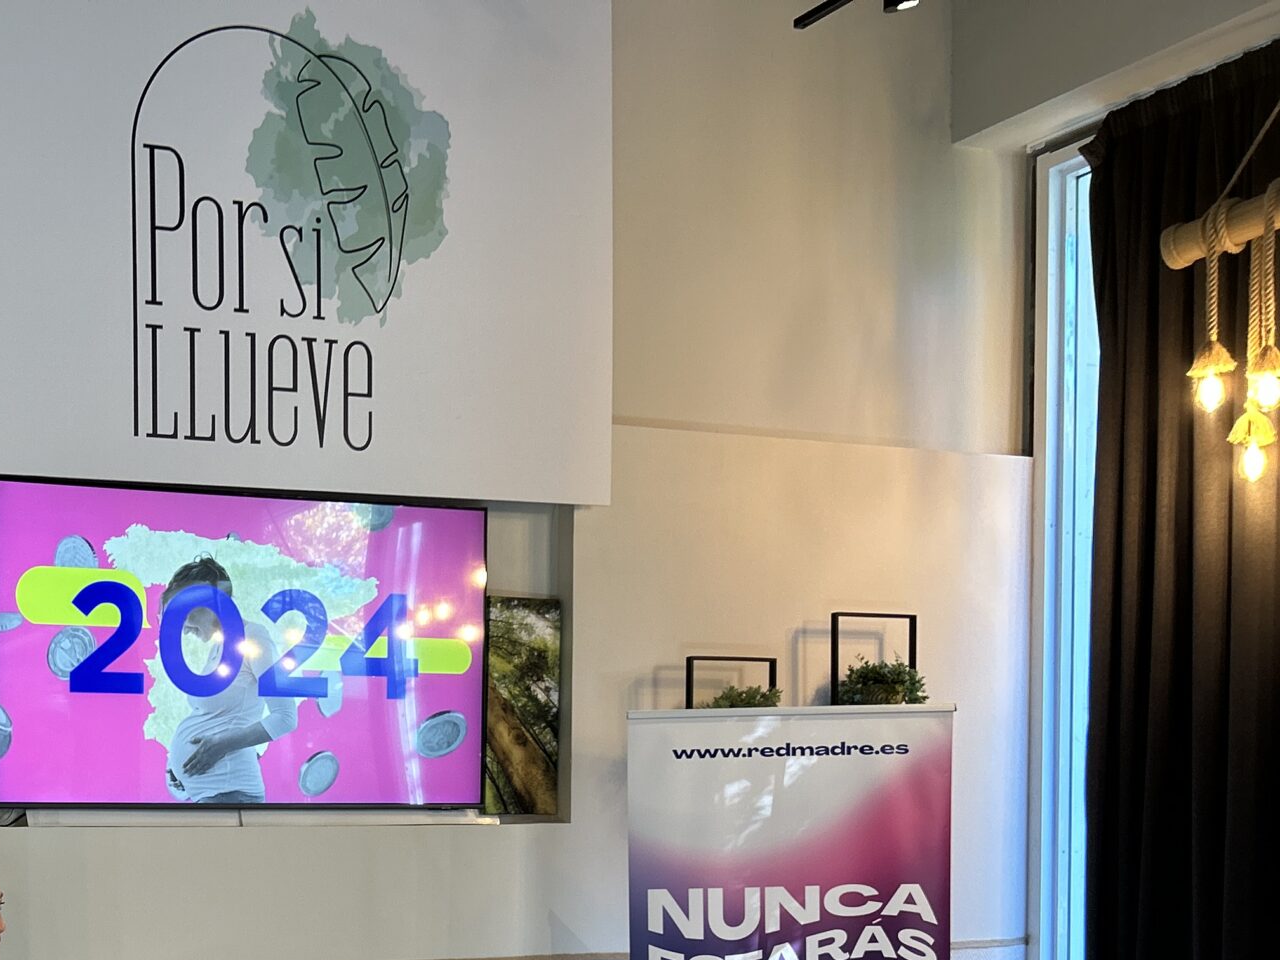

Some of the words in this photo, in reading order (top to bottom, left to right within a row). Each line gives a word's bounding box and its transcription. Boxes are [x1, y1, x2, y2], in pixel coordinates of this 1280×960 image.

[143, 143, 268, 312] Por
[279, 216, 325, 320] si
[69, 580, 419, 699] 2024
[672, 741, 910, 760] www.redmadre.es
[647, 883, 938, 940] NUNCA
